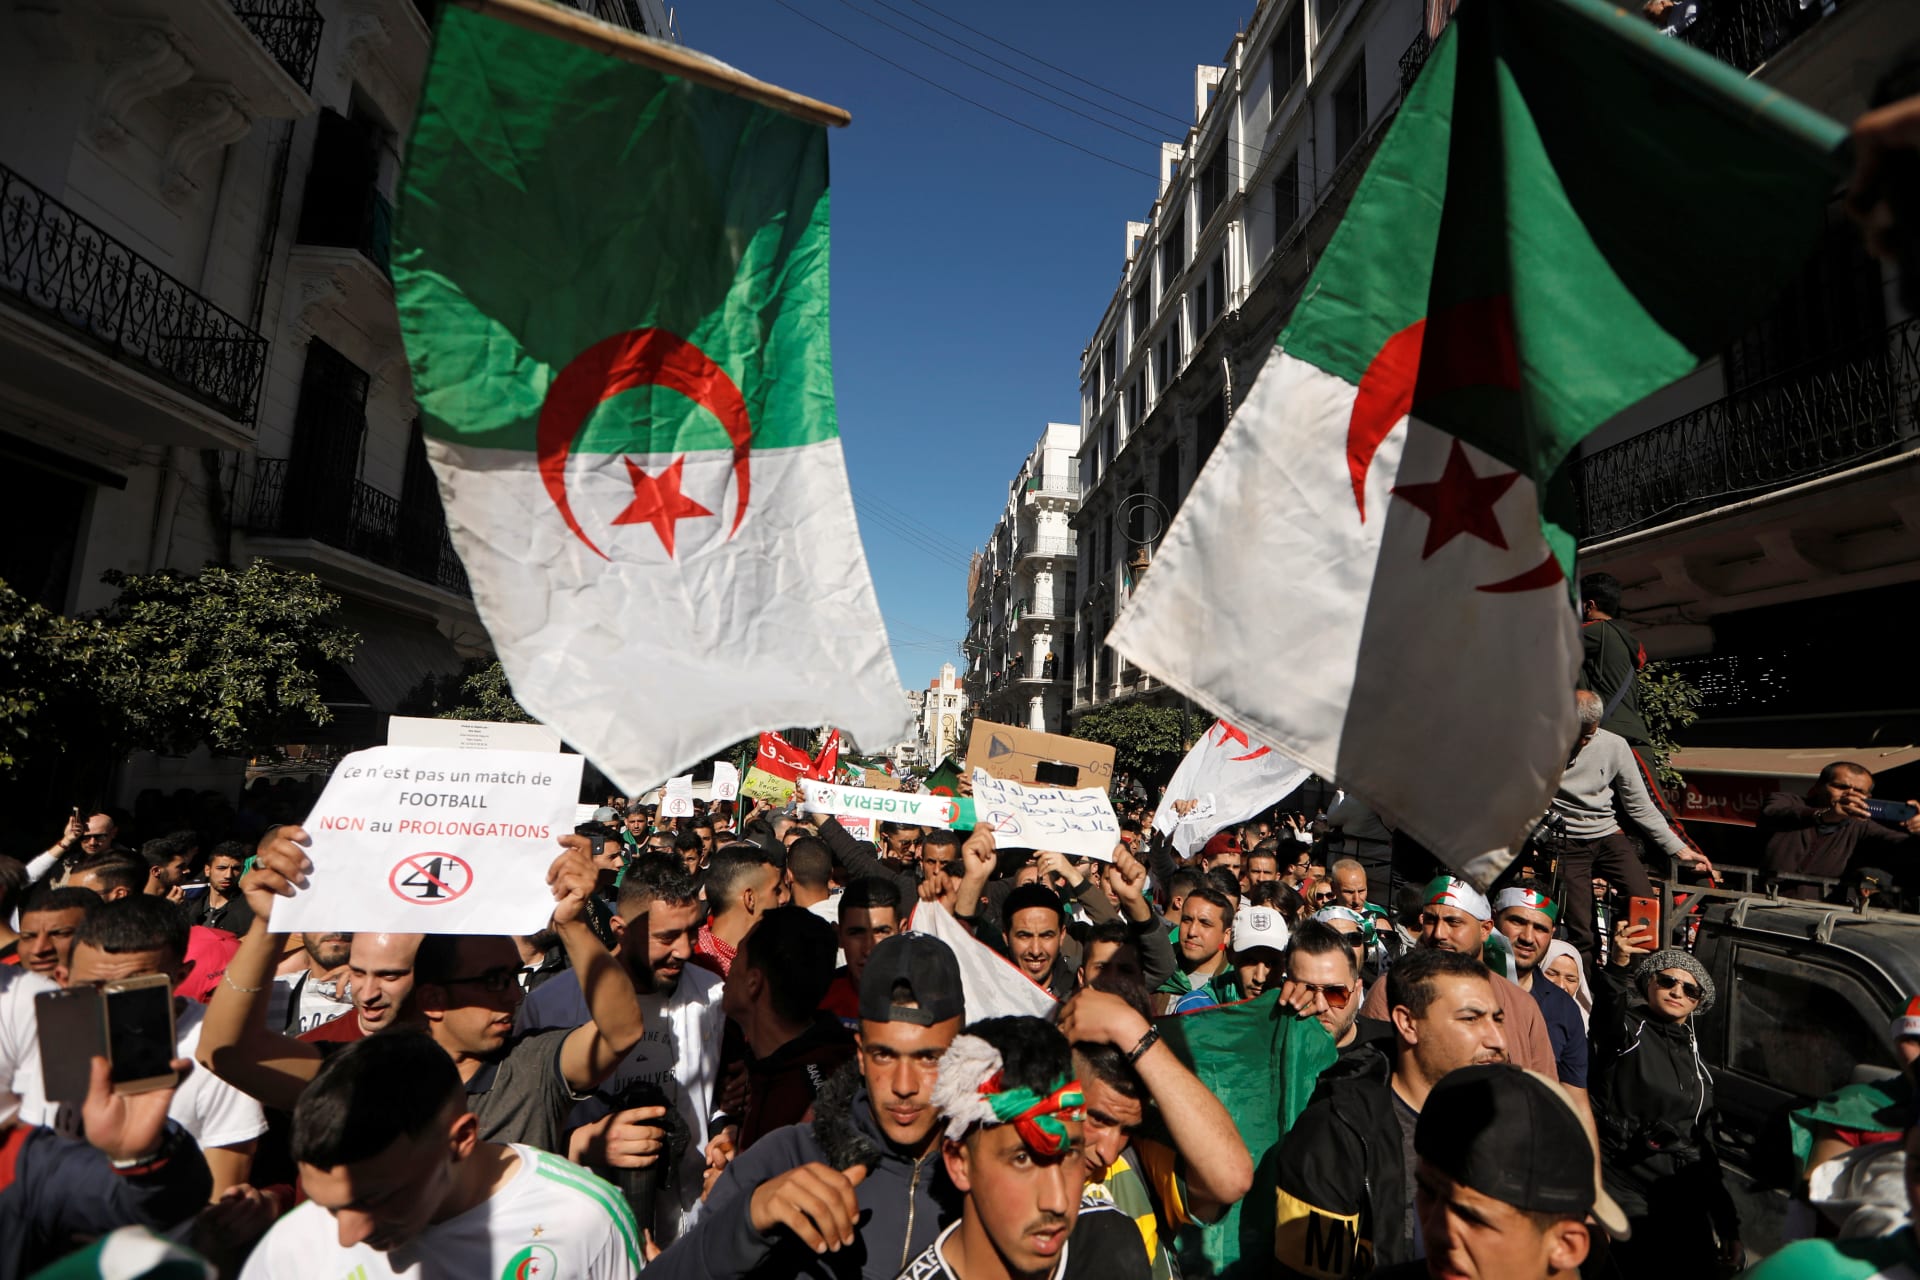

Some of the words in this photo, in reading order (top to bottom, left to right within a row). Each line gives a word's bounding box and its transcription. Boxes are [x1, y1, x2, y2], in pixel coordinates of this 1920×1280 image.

[414, 769, 445, 786] pas
[450, 772, 470, 784] un
[474, 770, 526, 786] match
[531, 771, 552, 786] de
[398, 791, 488, 809] FOOTBALL
[842, 792, 922, 814] ALGERIA
[1685, 791, 1728, 809] سريع
[319, 816, 365, 832] NON
[370, 821, 392, 833] au
[398, 819, 550, 839] PROLONGATIONS
